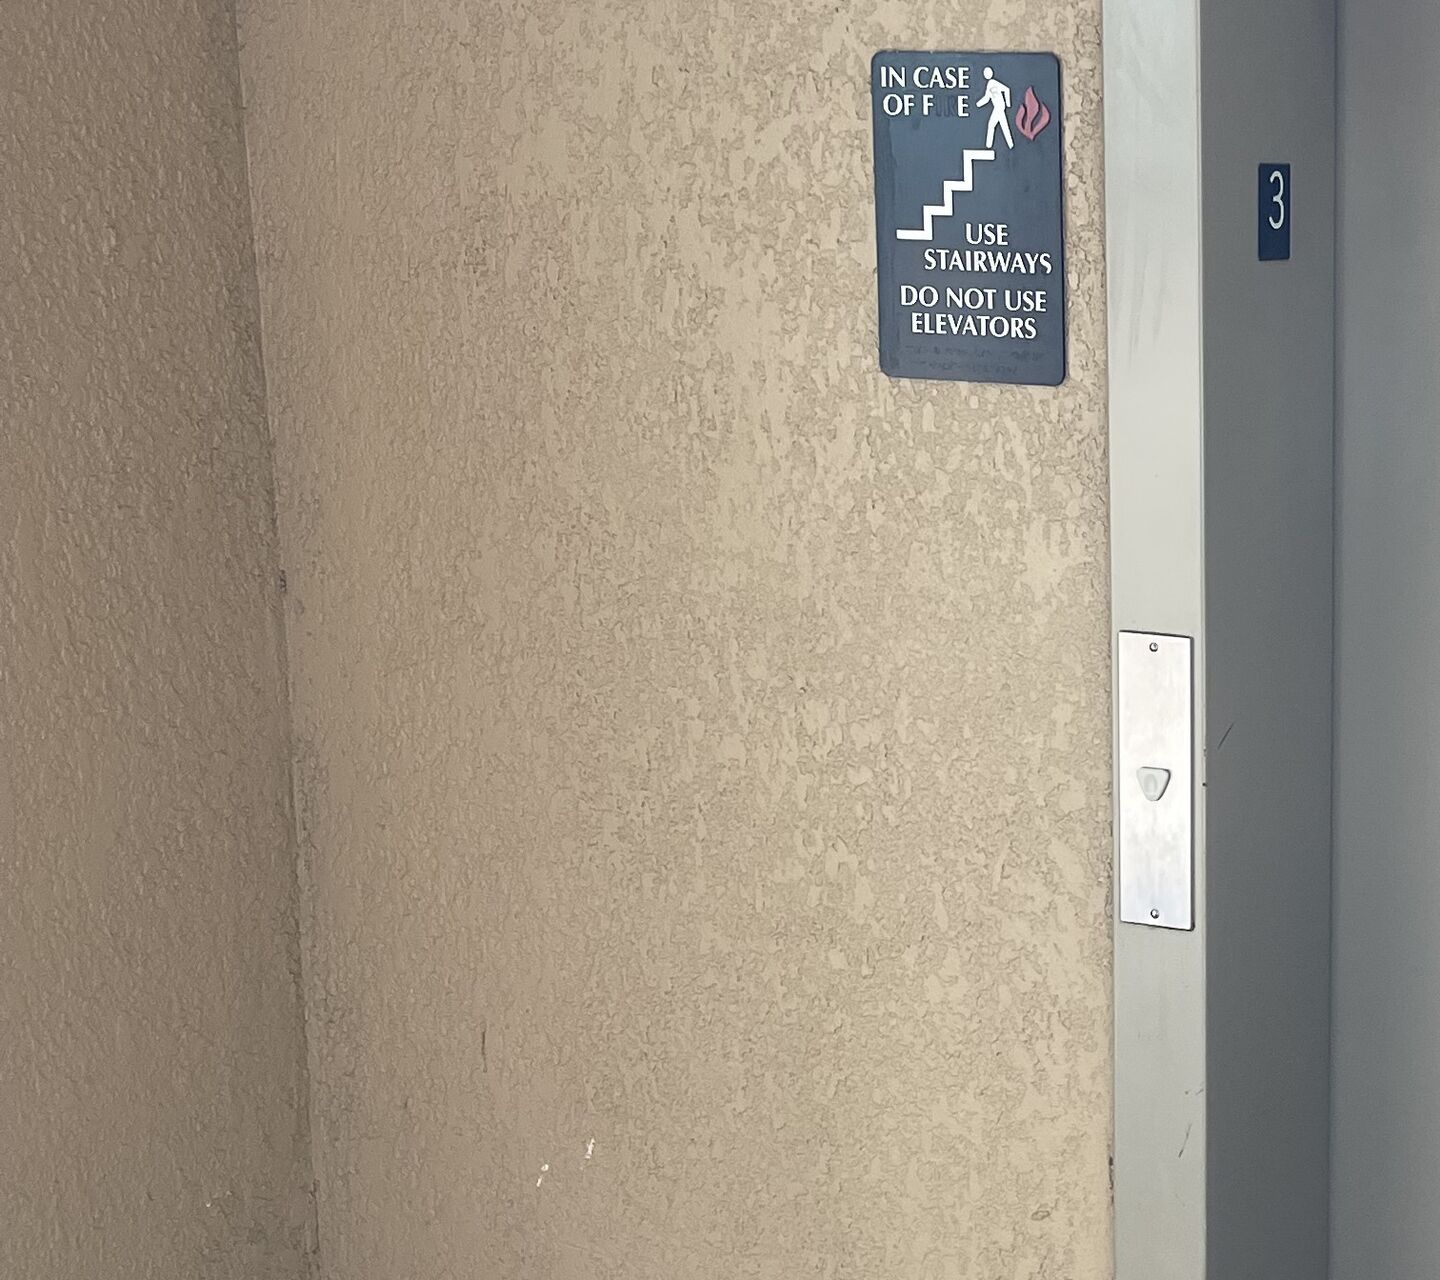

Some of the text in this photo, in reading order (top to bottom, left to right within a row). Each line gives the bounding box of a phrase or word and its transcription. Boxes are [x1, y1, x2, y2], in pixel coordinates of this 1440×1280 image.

[880, 66, 970, 89] IN CASE
[882, 94, 970, 117] OF FE
[1268, 170, 1285, 230] 3
[965, 223, 1008, 246] USE
[924, 248, 1052, 274] STAIRWAYS
[900, 285, 1047, 312] DO NOT USE
[911, 312, 1037, 339] ELEVATORS
